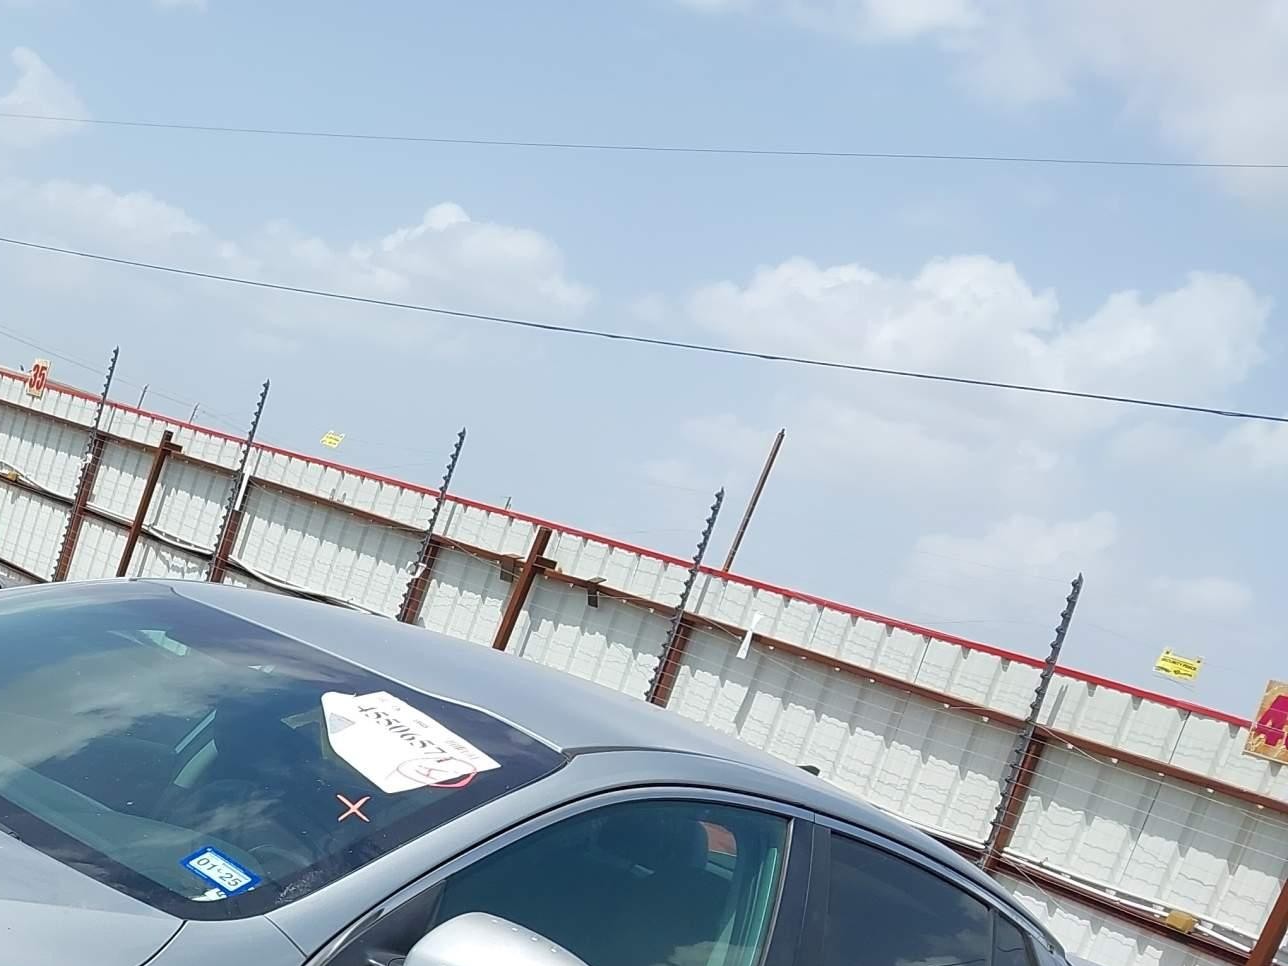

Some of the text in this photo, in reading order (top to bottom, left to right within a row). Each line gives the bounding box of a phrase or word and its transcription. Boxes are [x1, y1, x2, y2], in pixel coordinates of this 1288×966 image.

[29, 363, 48, 390] 35
[357, 704, 455, 764] 45506571
[196, 856, 217, 872] 01
[219, 872, 243, 888] 25
